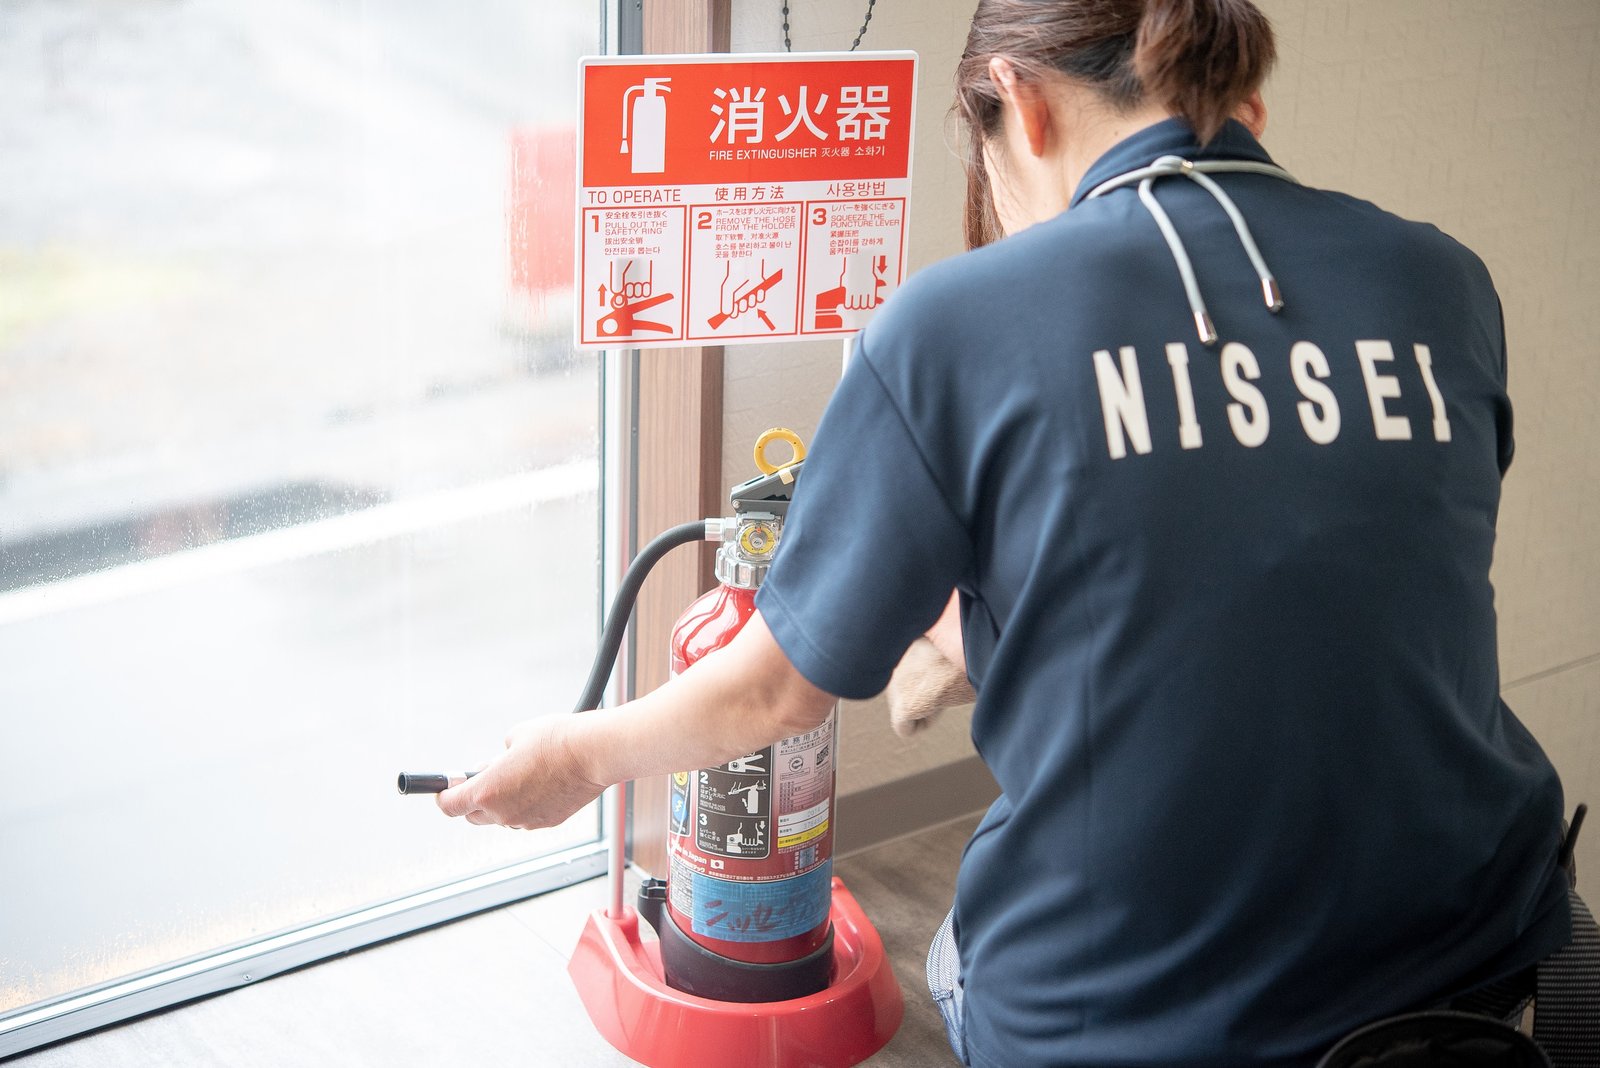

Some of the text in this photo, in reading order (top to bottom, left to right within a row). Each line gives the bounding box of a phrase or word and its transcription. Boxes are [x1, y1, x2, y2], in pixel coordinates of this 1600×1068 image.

[709, 85, 891, 144] 消火器
[709, 147, 817, 161] FIRE EXTINGUISHER
[821, 146, 850, 158] 灭火器
[854, 145, 885, 157] 소화기
[715, 185, 785, 201] 使用方法
[826, 181, 886, 198] 사용방법
[588, 188, 681, 204] TO OPERATE
[831, 202, 896, 212] レバーを強くにぎる
[605, 210, 668, 220] 安全栓を引き抜く
[697, 211, 712, 230] 2
[754, 216, 770, 224] THE
[772, 215, 796, 223] HOSE
[812, 207, 827, 226] 3
[831, 214, 867, 222] SQUEEZE
[592, 215, 599, 233] 1
[605, 221, 627, 229] PULL
[651, 220, 668, 228] THE
[743, 223, 759, 231] THE
[761, 222, 796, 230] HOLDER
[830, 219, 900, 228] PUNCTURE LEVER
[605, 227, 662, 236] SAFETY RING
[605, 247, 635, 256] 안전핀을
[1093, 340, 1452, 460] NISSEI
[699, 771, 709, 785] 2
[699, 813, 708, 826] 3
